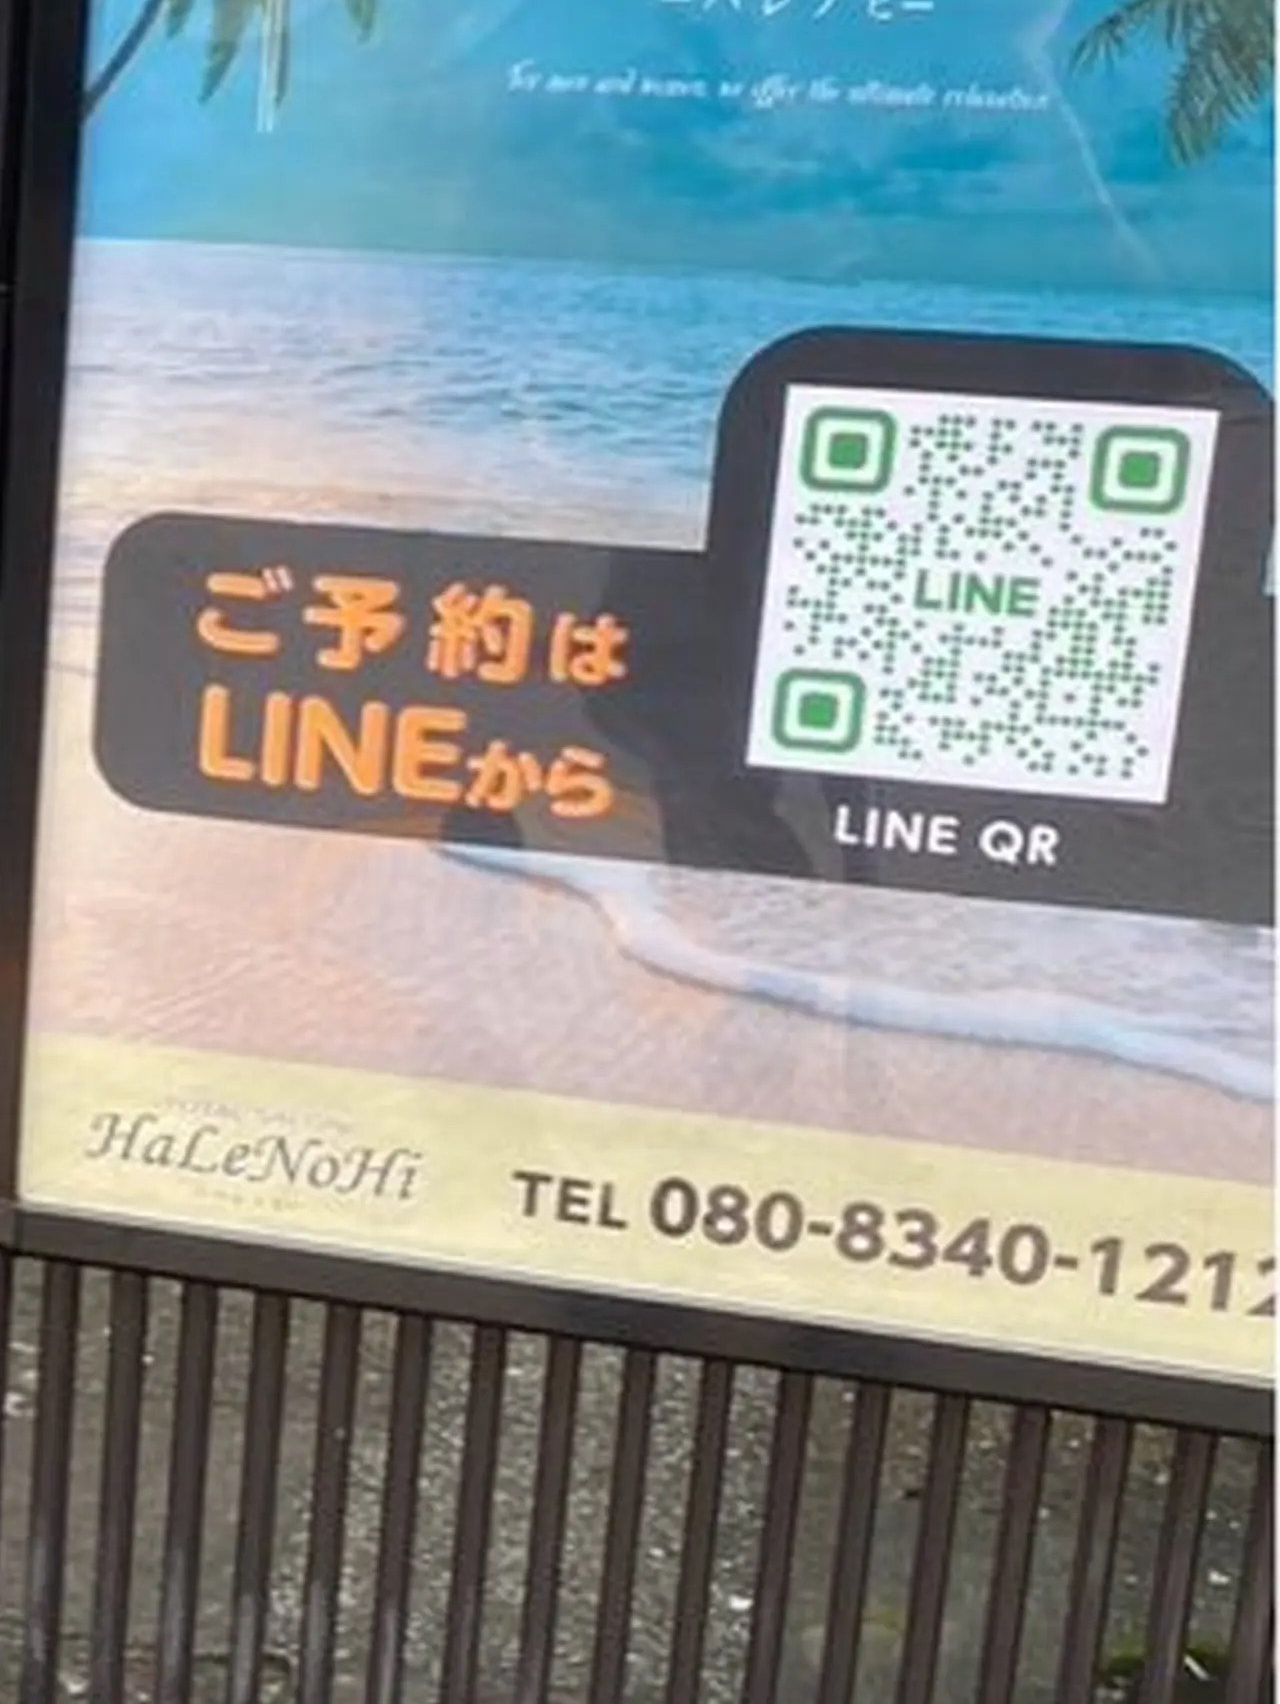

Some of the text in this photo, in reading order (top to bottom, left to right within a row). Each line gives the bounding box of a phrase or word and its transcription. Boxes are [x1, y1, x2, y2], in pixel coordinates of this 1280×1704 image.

[198, 564, 629, 686] ご予約は
[914, 567, 1039, 619] LINE
[200, 684, 615, 817] LINEから
[834, 806, 1061, 866] LINE QR
[83, 1111, 424, 1201] HaLeNoHi
[512, 1170, 626, 1230] TEL
